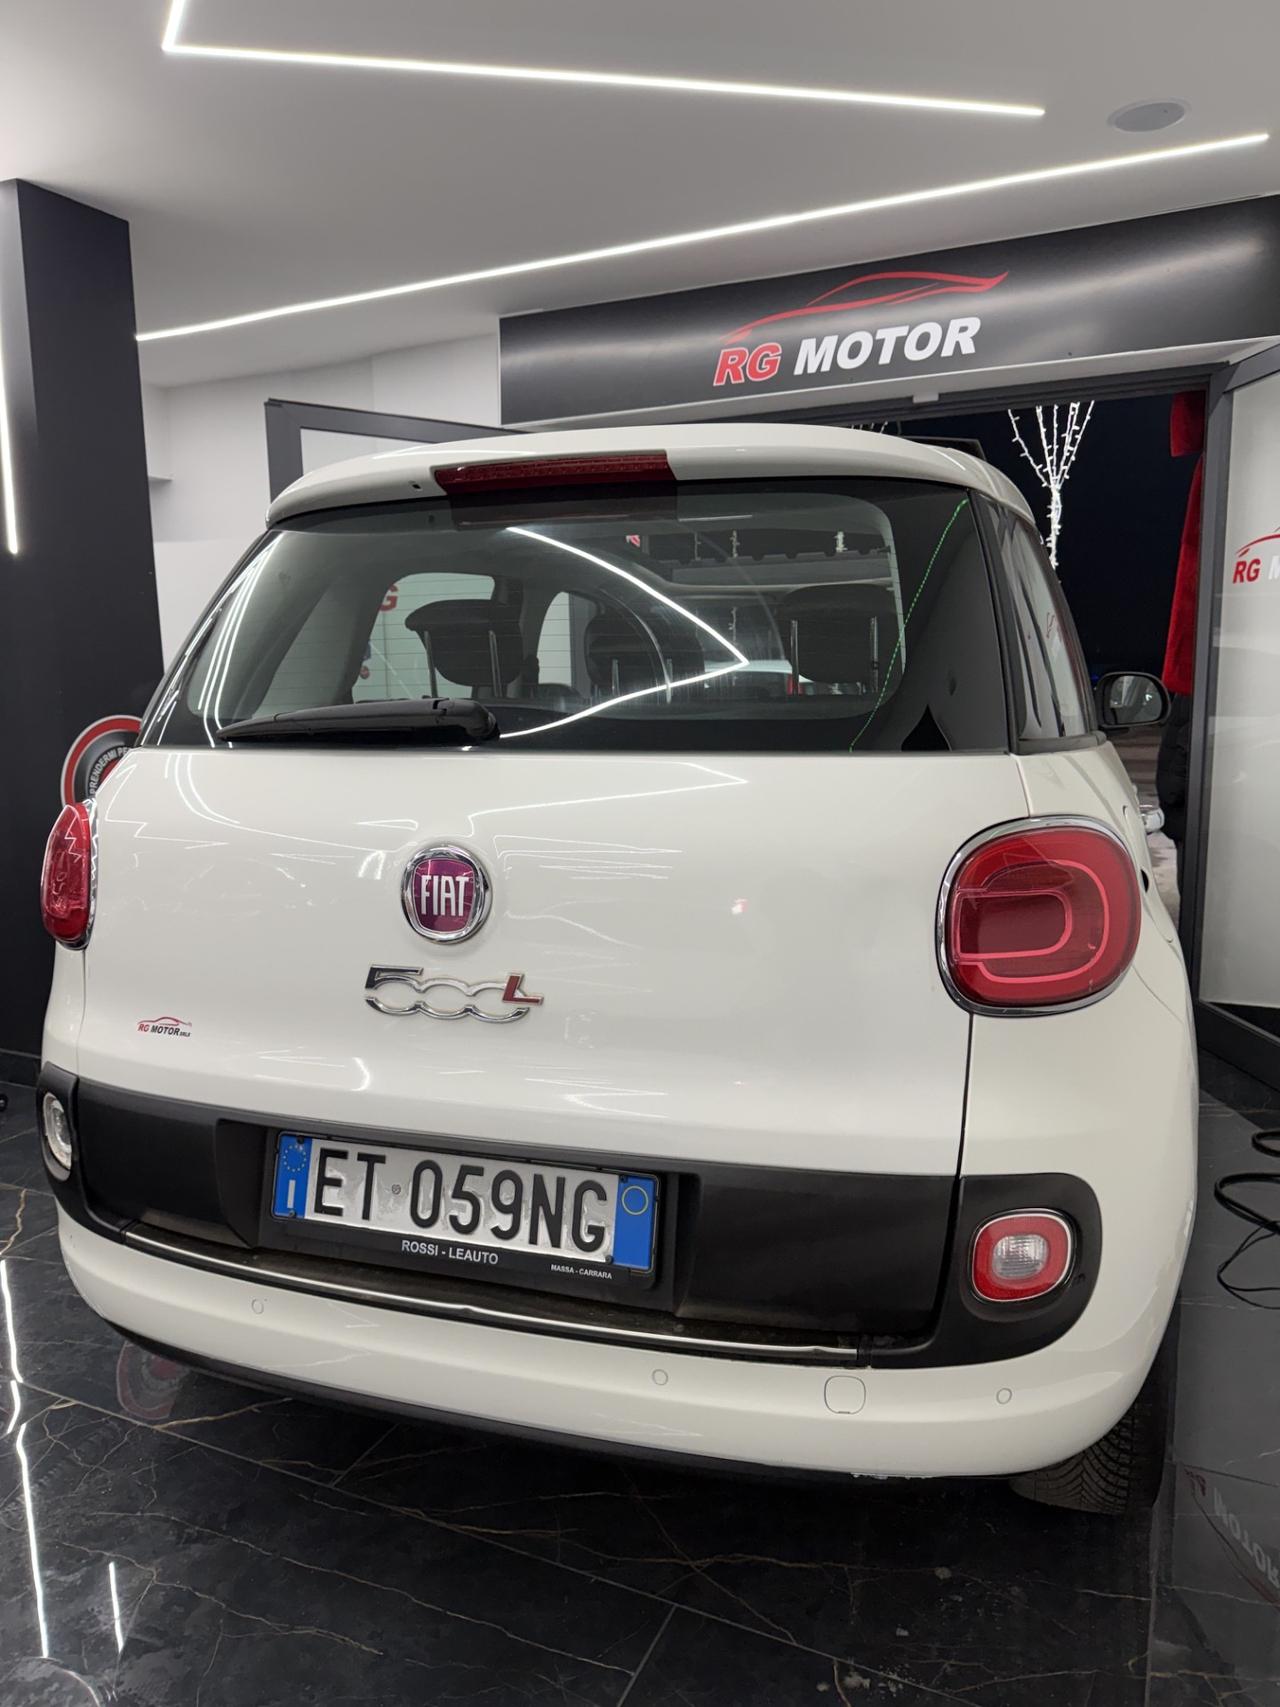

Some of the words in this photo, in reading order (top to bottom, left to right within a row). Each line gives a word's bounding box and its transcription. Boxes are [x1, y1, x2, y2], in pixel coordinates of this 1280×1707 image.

[713, 342, 782, 386] RG
[793, 316, 981, 375] MOTOR
[1232, 558, 1261, 584] RG
[420, 874, 469, 917] FIAT
[365, 964, 545, 1024] 500L
[138, 1024, 150, 1032] RG
[151, 1025, 180, 1036] MOTOR
[313, 1147, 386, 1222] ET
[409, 1159, 607, 1253] 059NG
[401, 1239, 438, 1257] ROSSI
[448, 1246, 499, 1265] LEAUTO
[550, 1263, 574, 1275] MASSA
[579, 1267, 612, 1280] CARRARA
